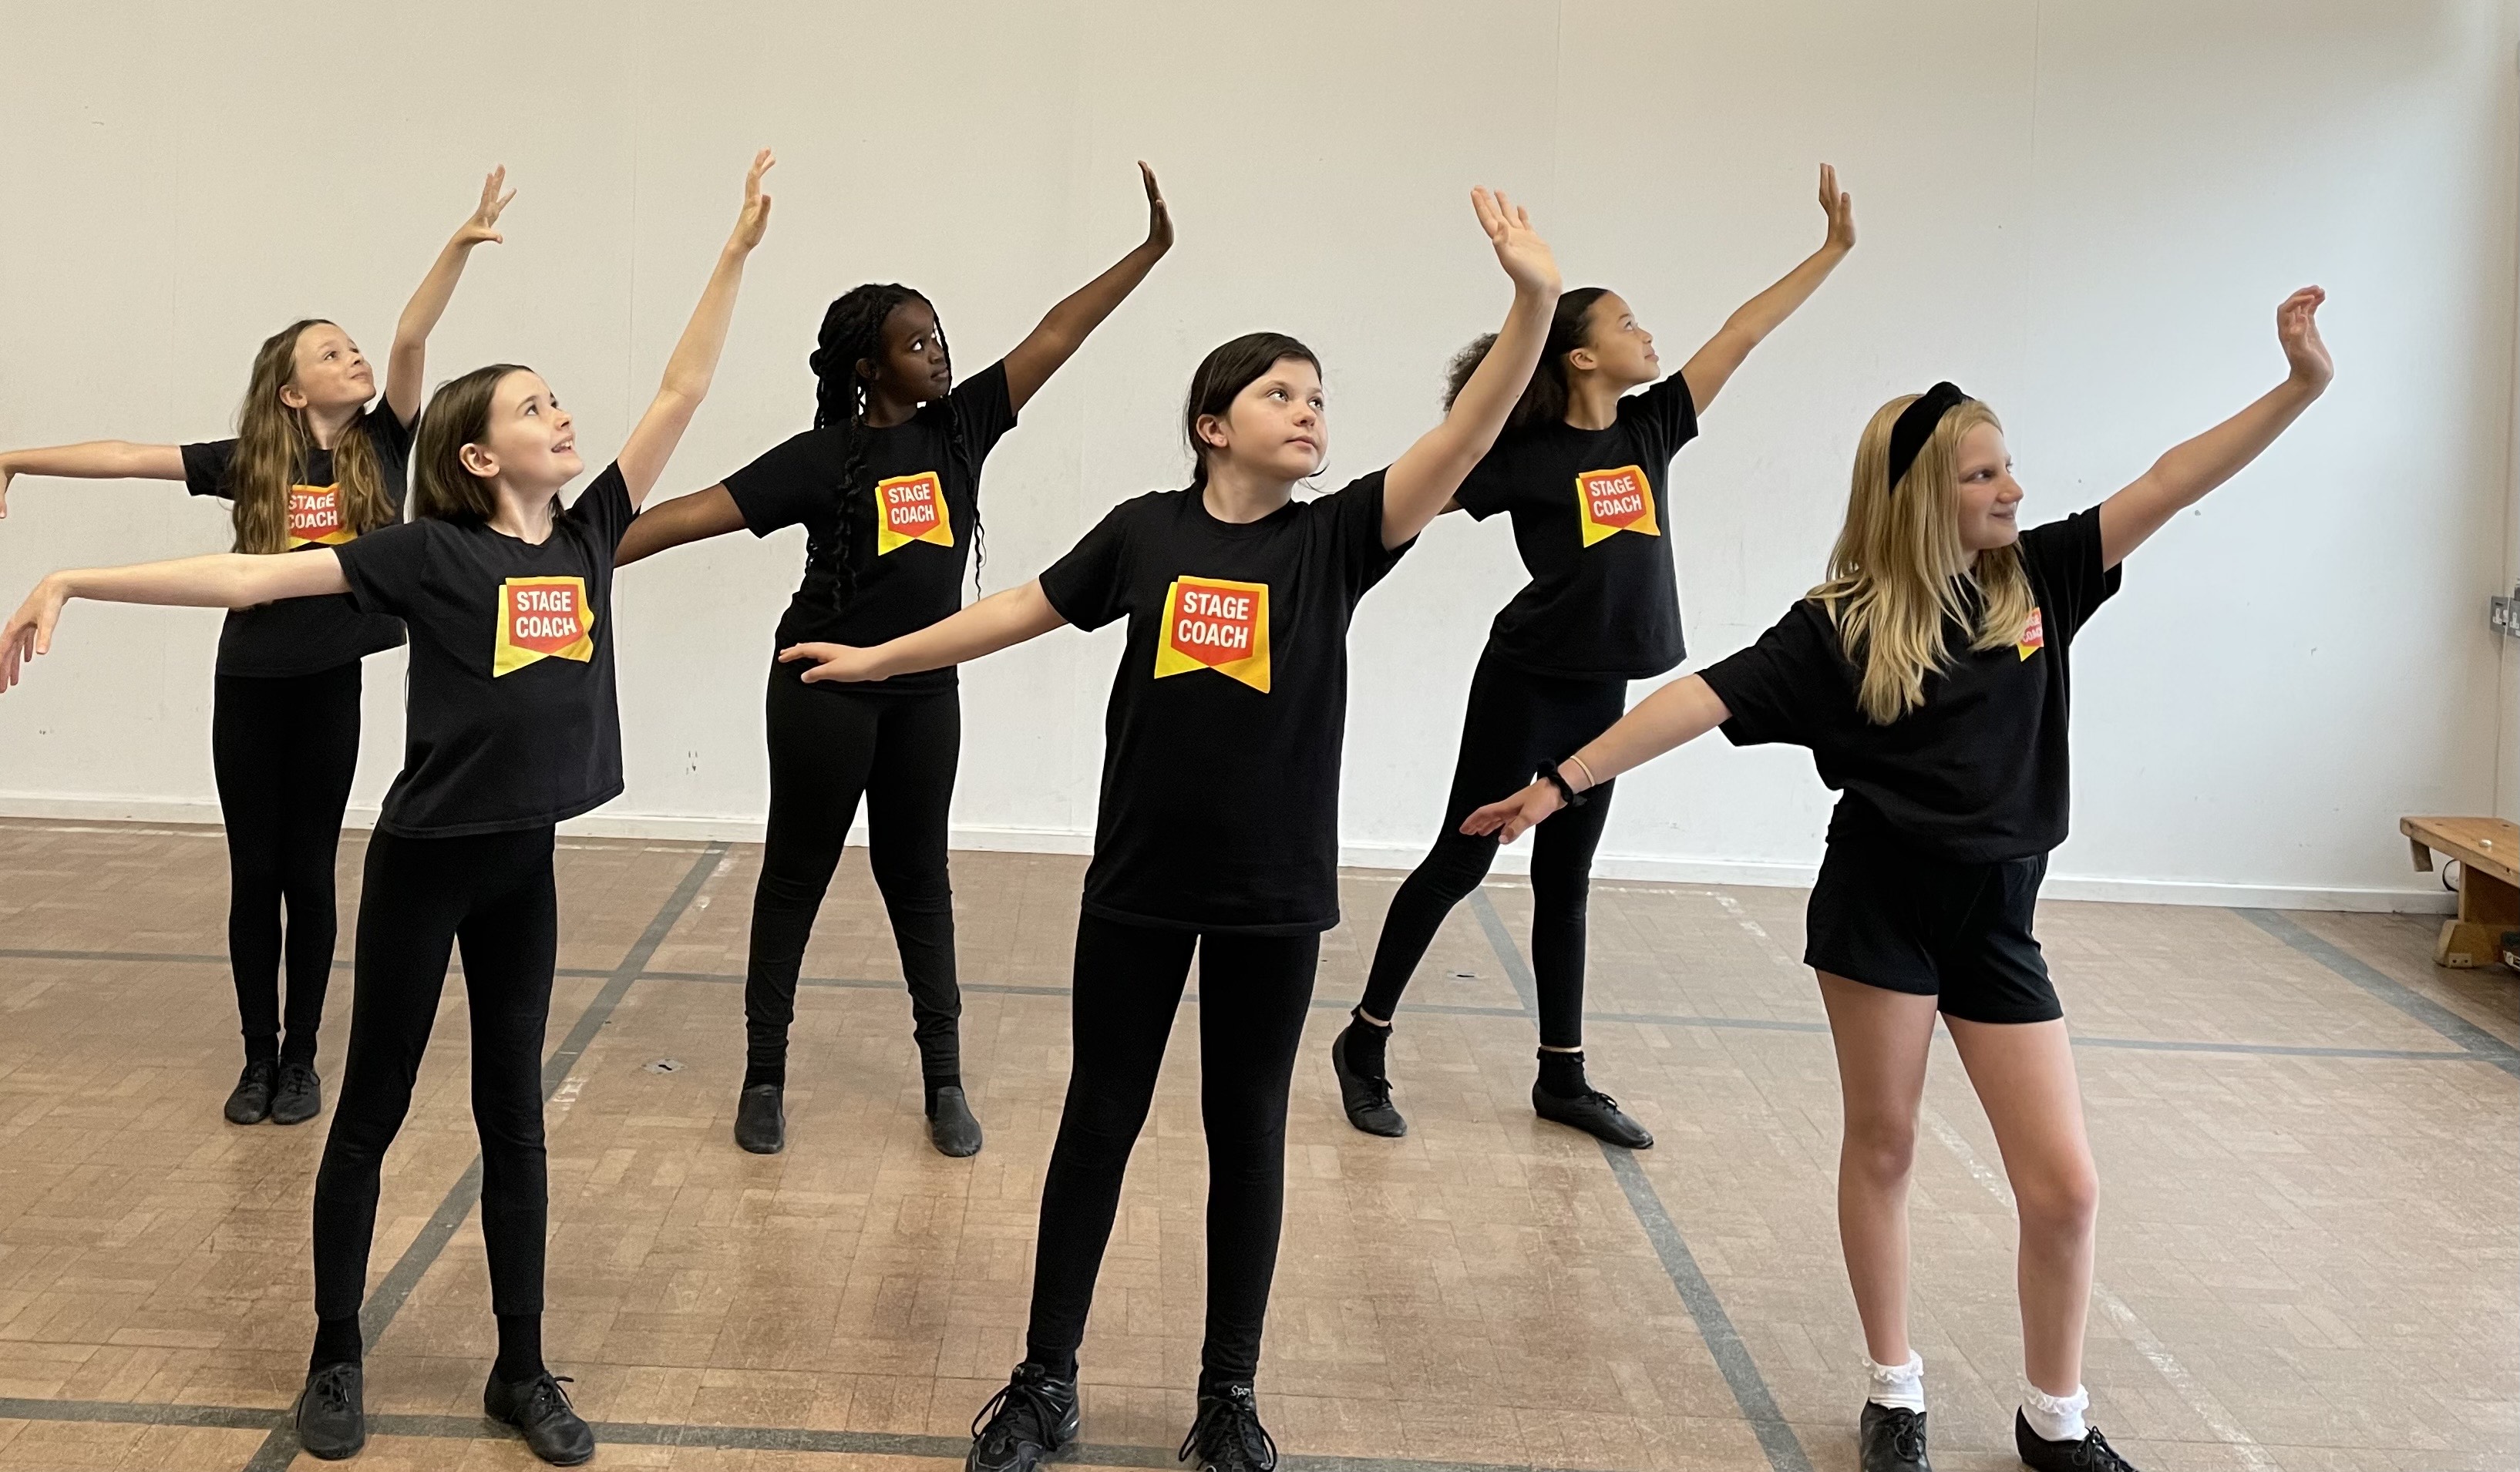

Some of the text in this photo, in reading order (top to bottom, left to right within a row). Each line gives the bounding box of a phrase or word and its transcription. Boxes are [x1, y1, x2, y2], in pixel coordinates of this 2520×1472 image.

[888, 483, 931, 503] STAGE
[1590, 476, 1636, 497] STAGE
[288, 492, 335, 510] STAGE
[1593, 494, 1643, 517] COACH
[890, 505, 935, 525] COACH
[516, 590, 572, 612] STAGE
[1183, 591, 1250, 620] STAGE
[516, 616, 577, 638] COACH
[1178, 619, 1249, 649] COACH
